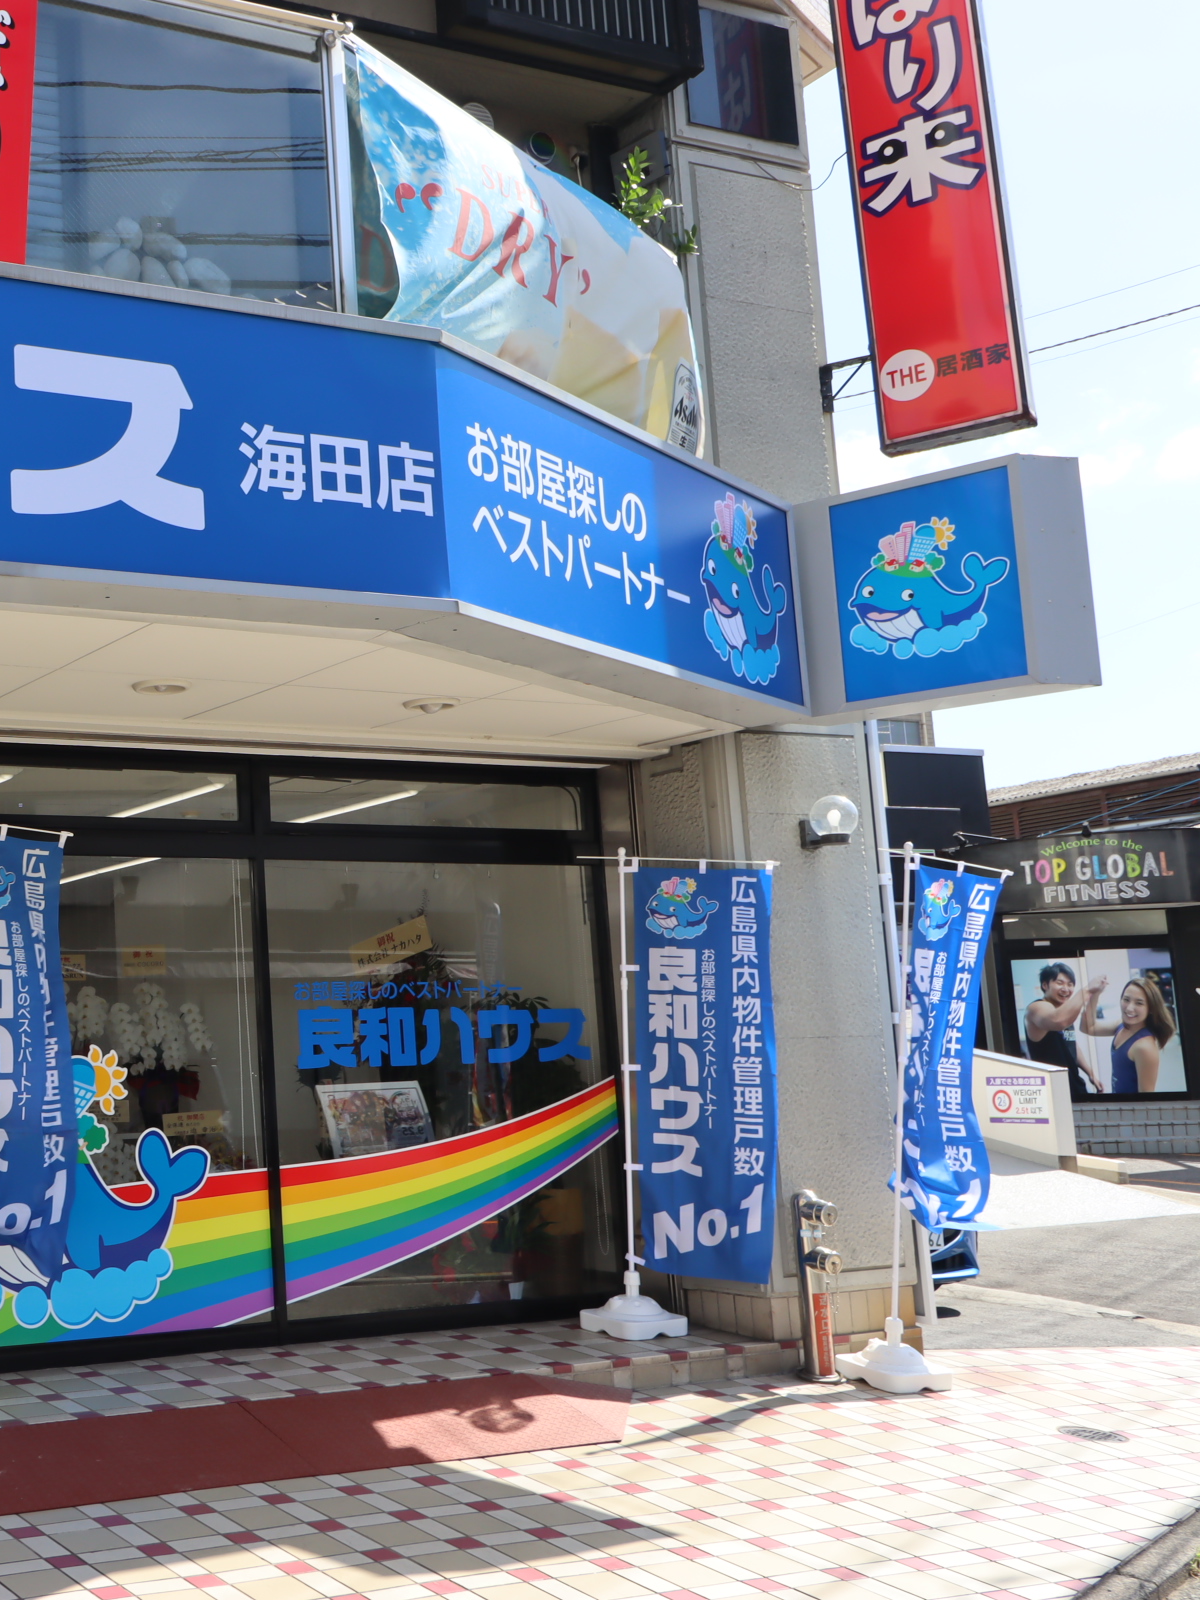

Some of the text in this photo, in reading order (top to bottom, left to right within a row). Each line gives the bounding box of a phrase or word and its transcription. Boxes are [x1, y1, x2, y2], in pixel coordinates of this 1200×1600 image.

[886, 342, 1011, 389] THE 居酒家
[239, 421, 437, 517] 海田店
[466, 422, 647, 542] お部屋探しの
[472, 504, 692, 611] ベストパートナー
[1020, 851, 1174, 885] TOP GLOBAL
[1040, 838, 1143, 857] Welcome to the
[1043, 880, 1150, 903] FITNESS
[293, 980, 523, 1001] お部屋探しのベストパートナー
[731, 876, 765, 1177] 広島県内物件管理戸数
[933, 883, 996, 1173] 広島県内物件管理戸数
[297, 1005, 592, 1070] 良和ハウス
[648, 946, 704, 1177] 良和ハウス
[701, 949, 717, 1129] お部屋探しのベストパートナー
[1013, 1089, 1042, 1097] WEIGHT
[653, 1183, 764, 1259] No.1
